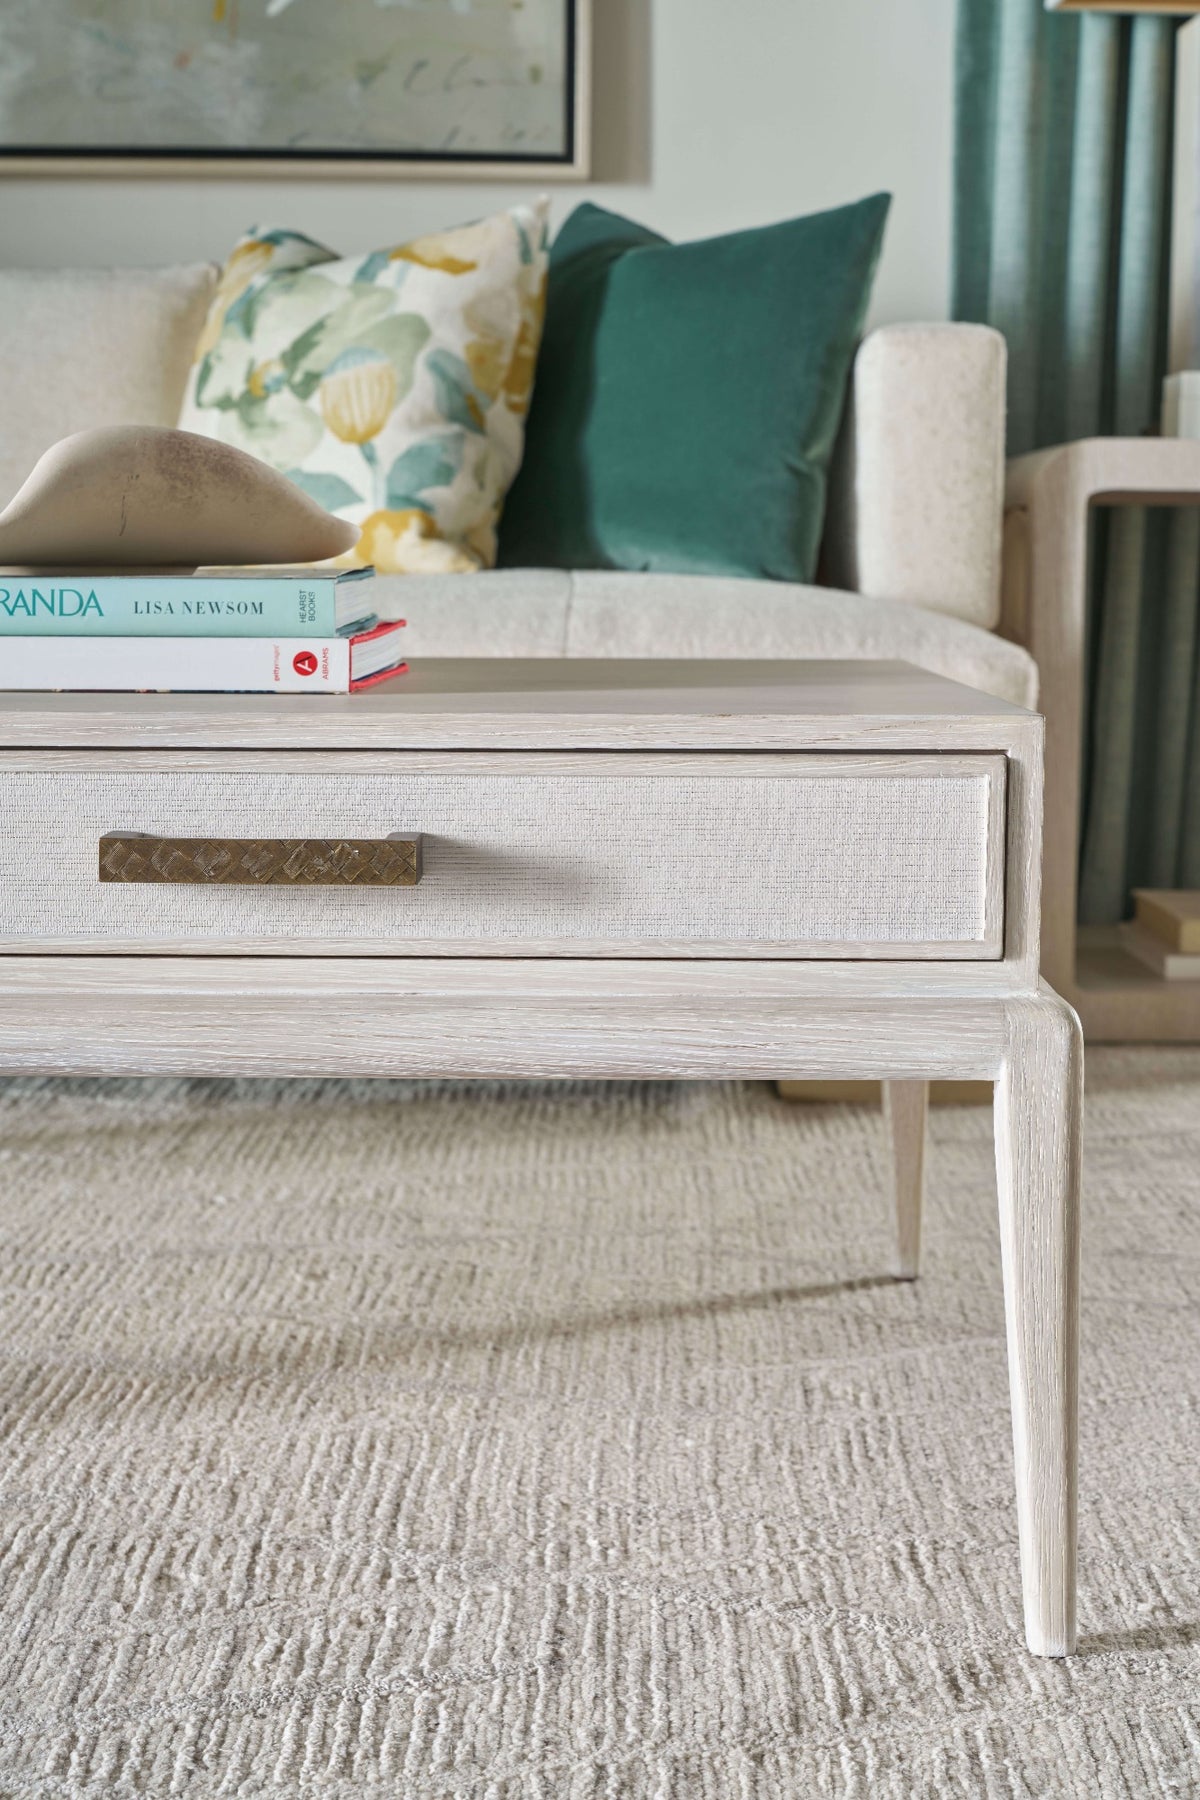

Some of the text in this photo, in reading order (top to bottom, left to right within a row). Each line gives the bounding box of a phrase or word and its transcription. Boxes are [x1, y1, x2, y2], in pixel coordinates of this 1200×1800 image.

[133, 600, 264, 615] LISA NEWSOM
[299, 590, 307, 623] HEARST
[308, 591, 316, 622] BOOKS
[322, 647, 330, 680] ABRAMS
